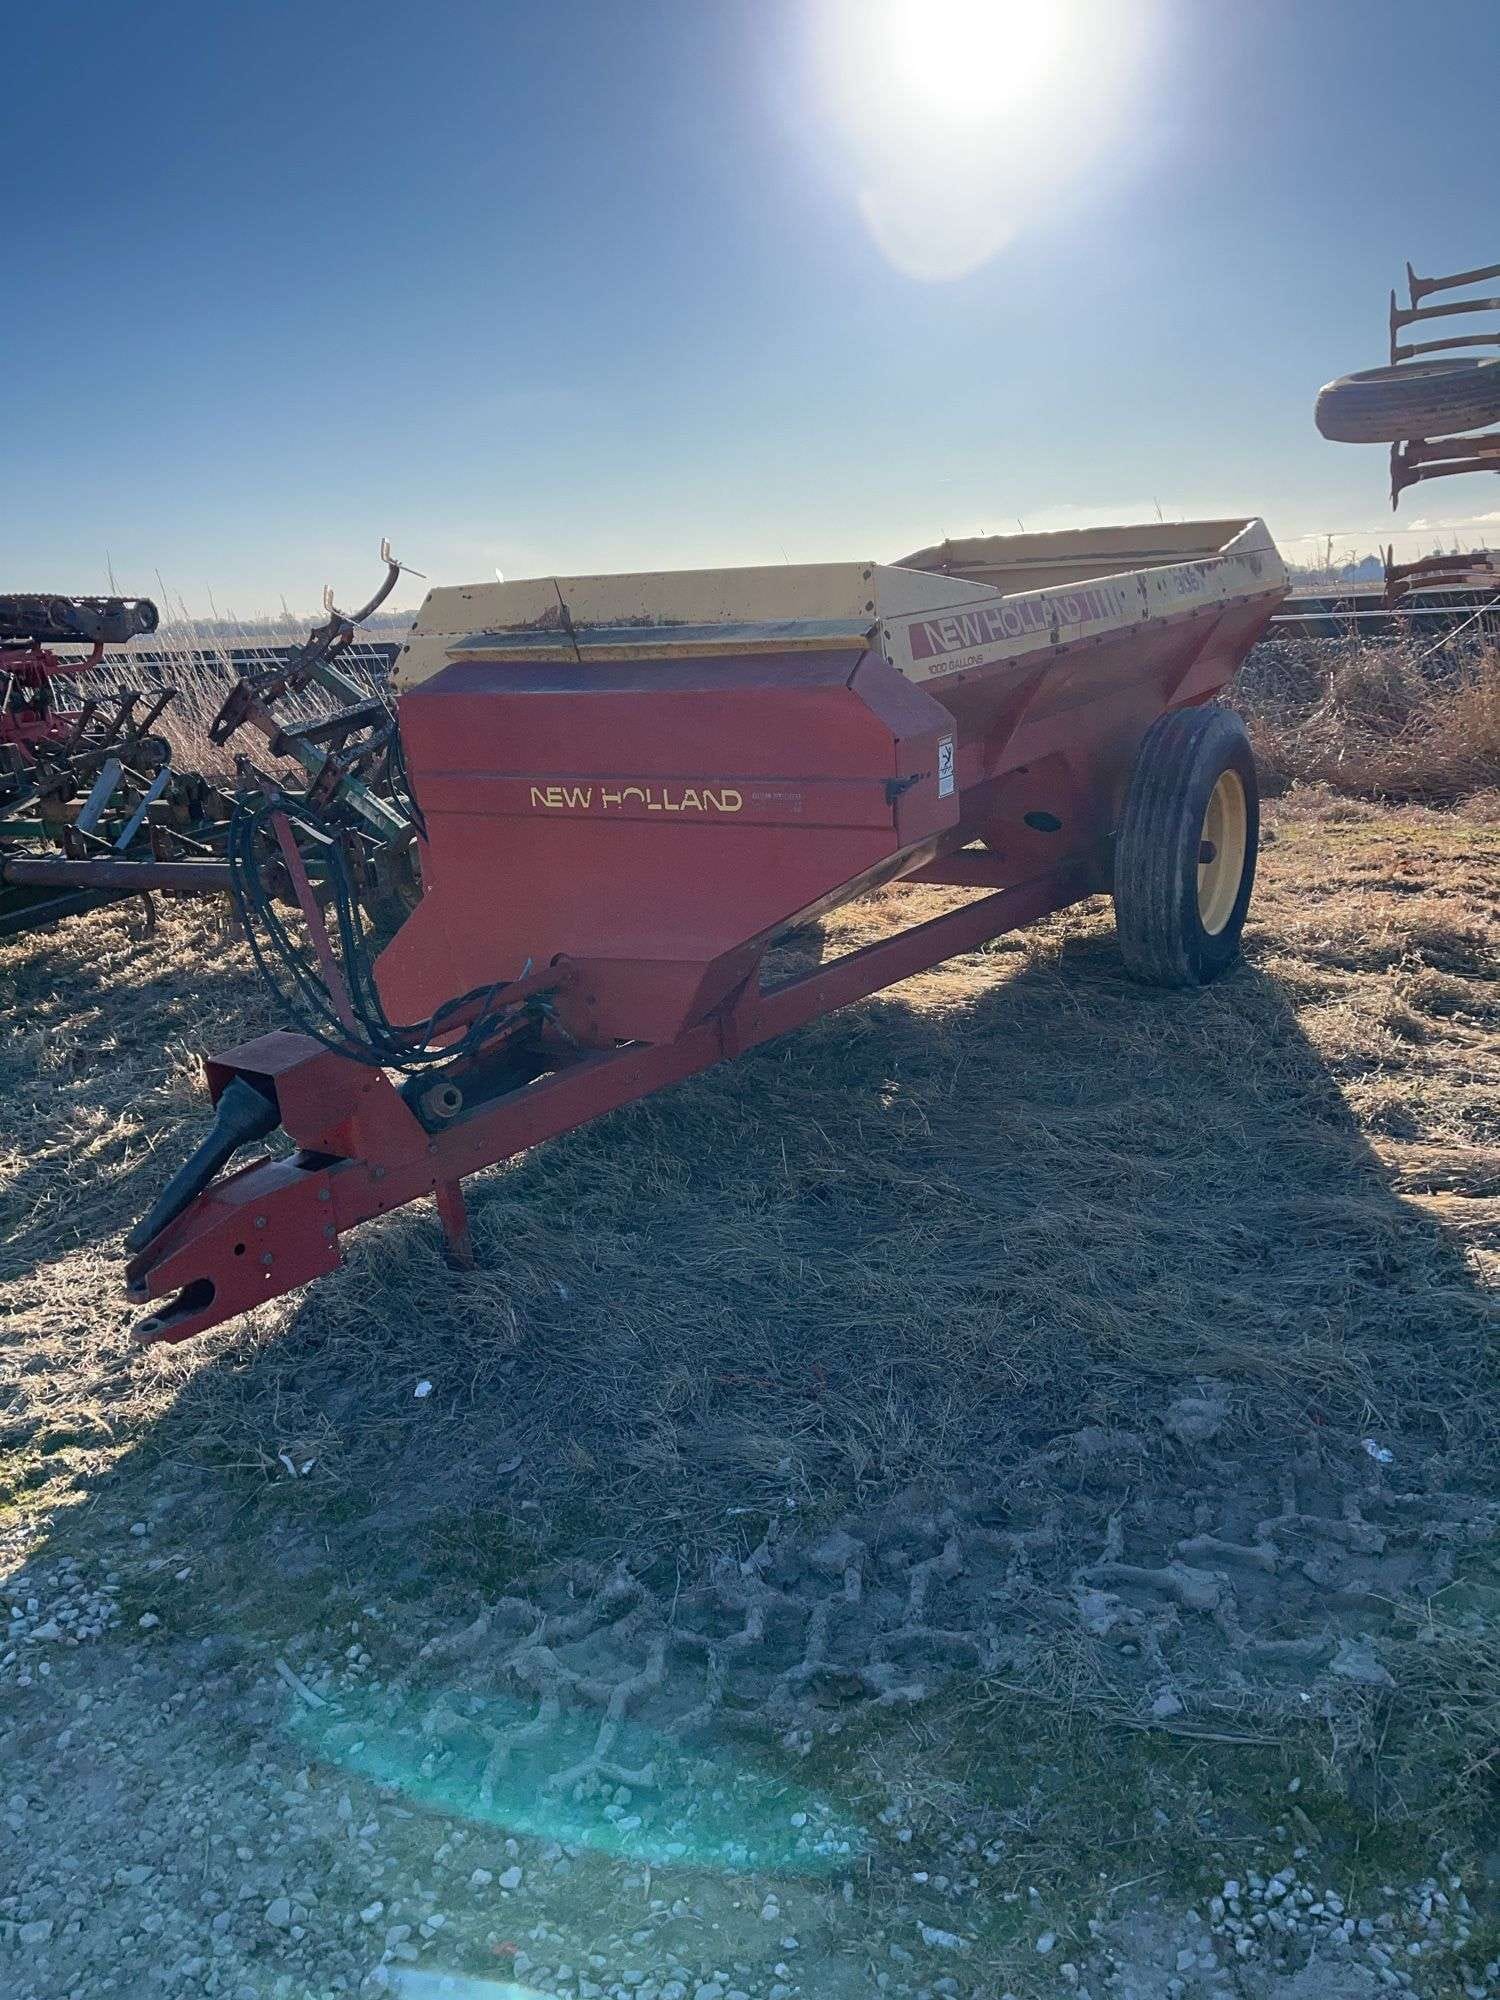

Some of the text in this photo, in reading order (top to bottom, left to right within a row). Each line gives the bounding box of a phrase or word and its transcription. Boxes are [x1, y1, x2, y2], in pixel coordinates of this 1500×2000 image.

[922, 597, 1081, 654] NEW HOLLAND
[928, 654, 983, 674] 1000 GALLONS
[530, 787, 743, 811] NEW HOLLAND
